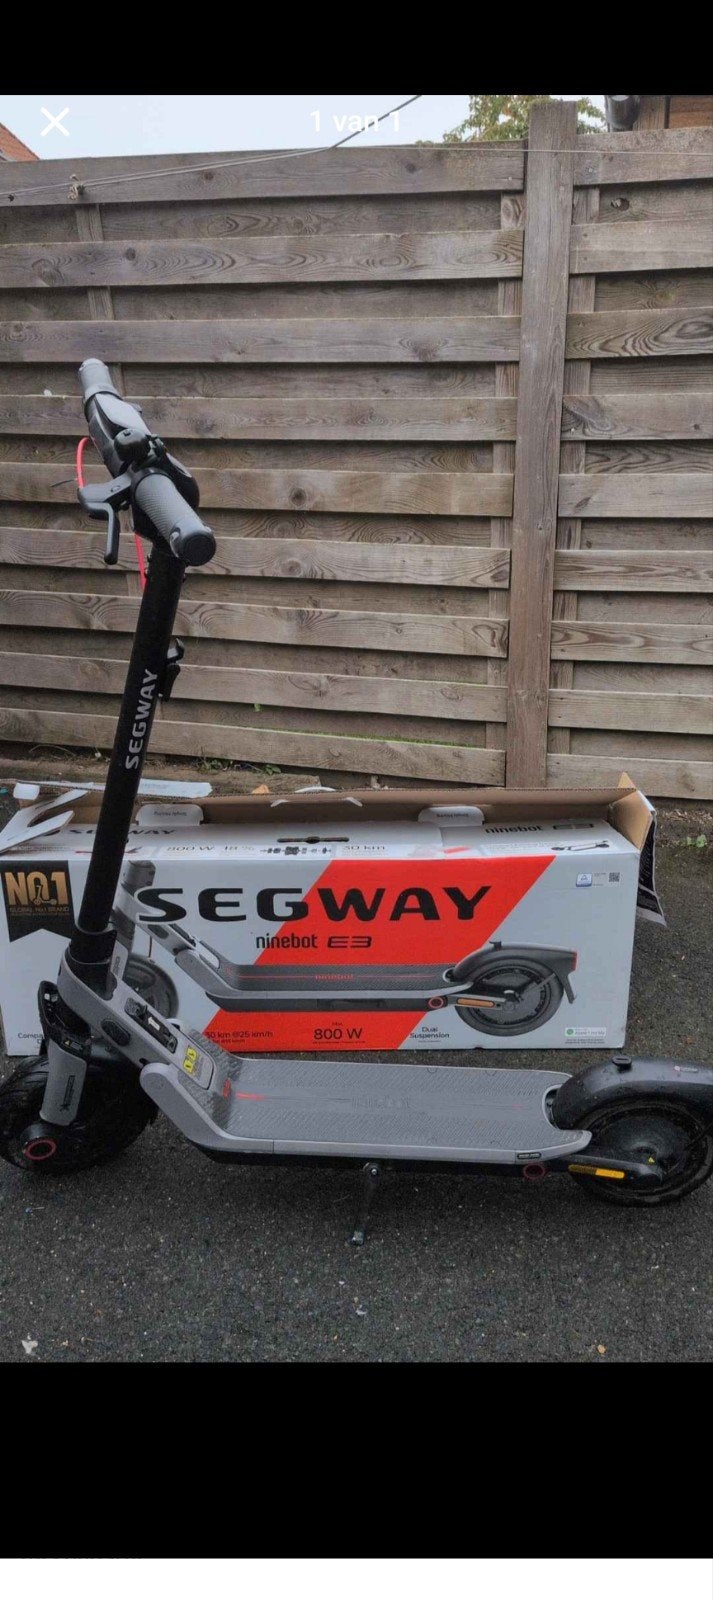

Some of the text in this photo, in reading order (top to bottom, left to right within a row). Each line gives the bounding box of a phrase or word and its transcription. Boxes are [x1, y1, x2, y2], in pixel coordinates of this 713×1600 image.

[125, 668, 158, 770] SEGWAY
[136, 885, 492, 923] SEGWAY
[256, 932, 373, 949] ninebot E3
[217, 1030, 231, 1039] km
[251, 1030, 274, 1038] km/h
[313, 1027, 363, 1040] 800 W
[409, 1032, 450, 1040] Suspension
